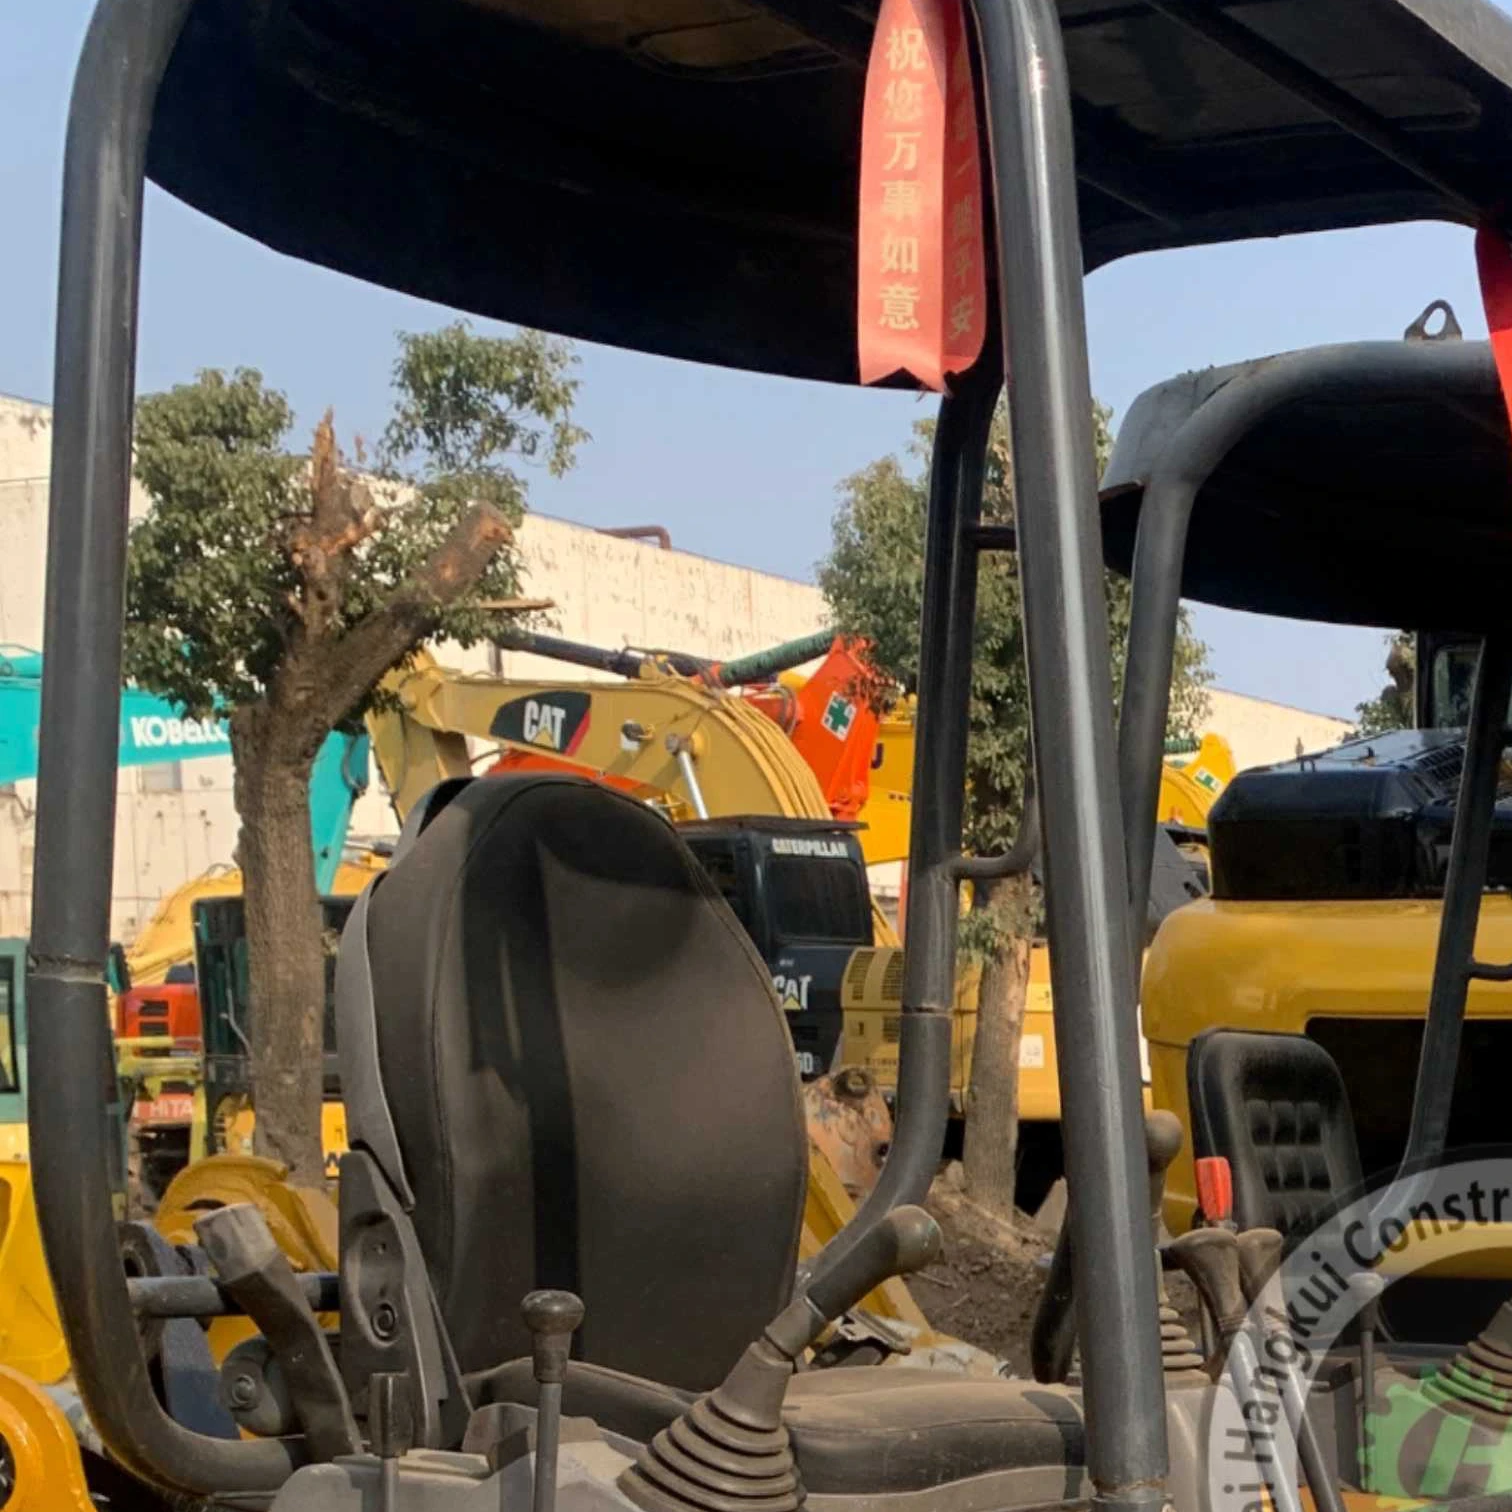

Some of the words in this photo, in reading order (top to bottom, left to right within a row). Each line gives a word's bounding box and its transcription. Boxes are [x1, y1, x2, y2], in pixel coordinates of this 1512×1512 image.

[523, 699, 567, 751] CAT
[772, 837, 849, 859] CATERPILLAR
[772, 974, 813, 1010] CAT
[149, 1099, 193, 1118] HITA
